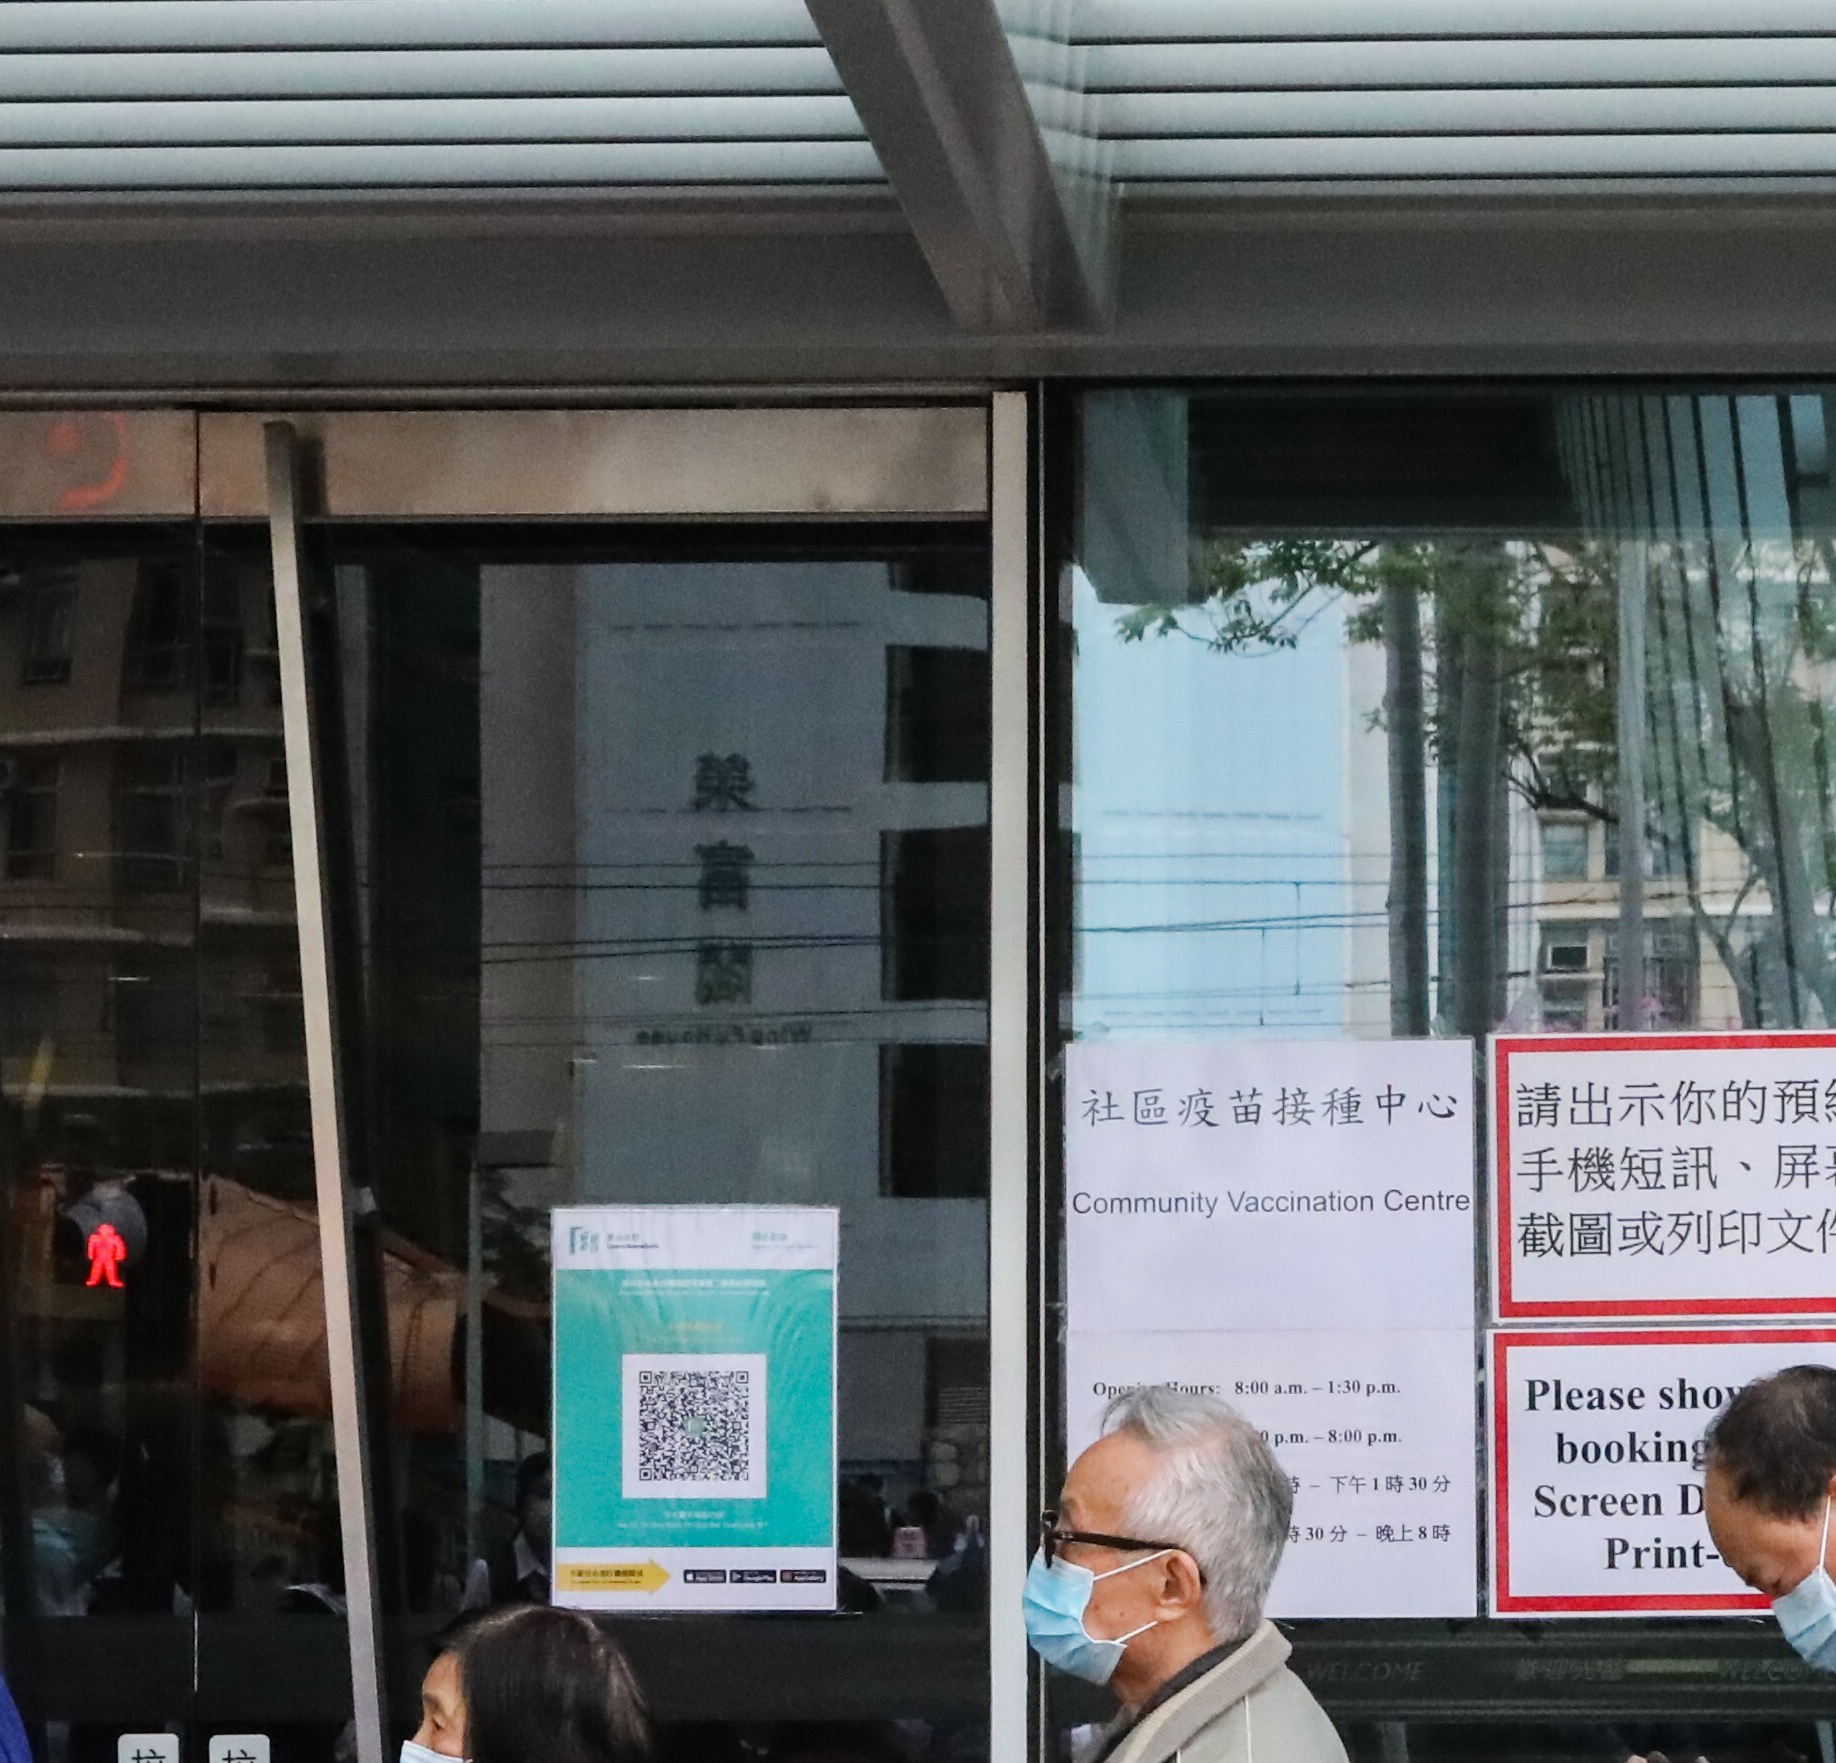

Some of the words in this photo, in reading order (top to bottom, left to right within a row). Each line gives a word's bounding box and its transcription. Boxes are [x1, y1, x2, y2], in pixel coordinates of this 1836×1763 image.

[1081, 1083, 1458, 1128] 社區疫苗接種中心
[1072, 1191, 1218, 1219] Community
[1227, 1190, 1374, 1213] Vaccination
[1383, 1189, 1470, 1212] Centre
[1234, 1381, 1269, 1395] 8:00
[1274, 1384, 1307, 1395] a.m.
[1329, 1379, 1361, 1394] 1:30
[1366, 1383, 1401, 1397] p.m.
[1526, 1379, 1645, 1411] Please
[1274, 1433, 1308, 1448] p.m.
[1328, 1429, 1362, 1443] 8:00
[1367, 1432, 1402, 1447] p.m.
[1534, 1484, 1663, 1518] Screen
[1603, 1537, 1720, 1569] Print-
